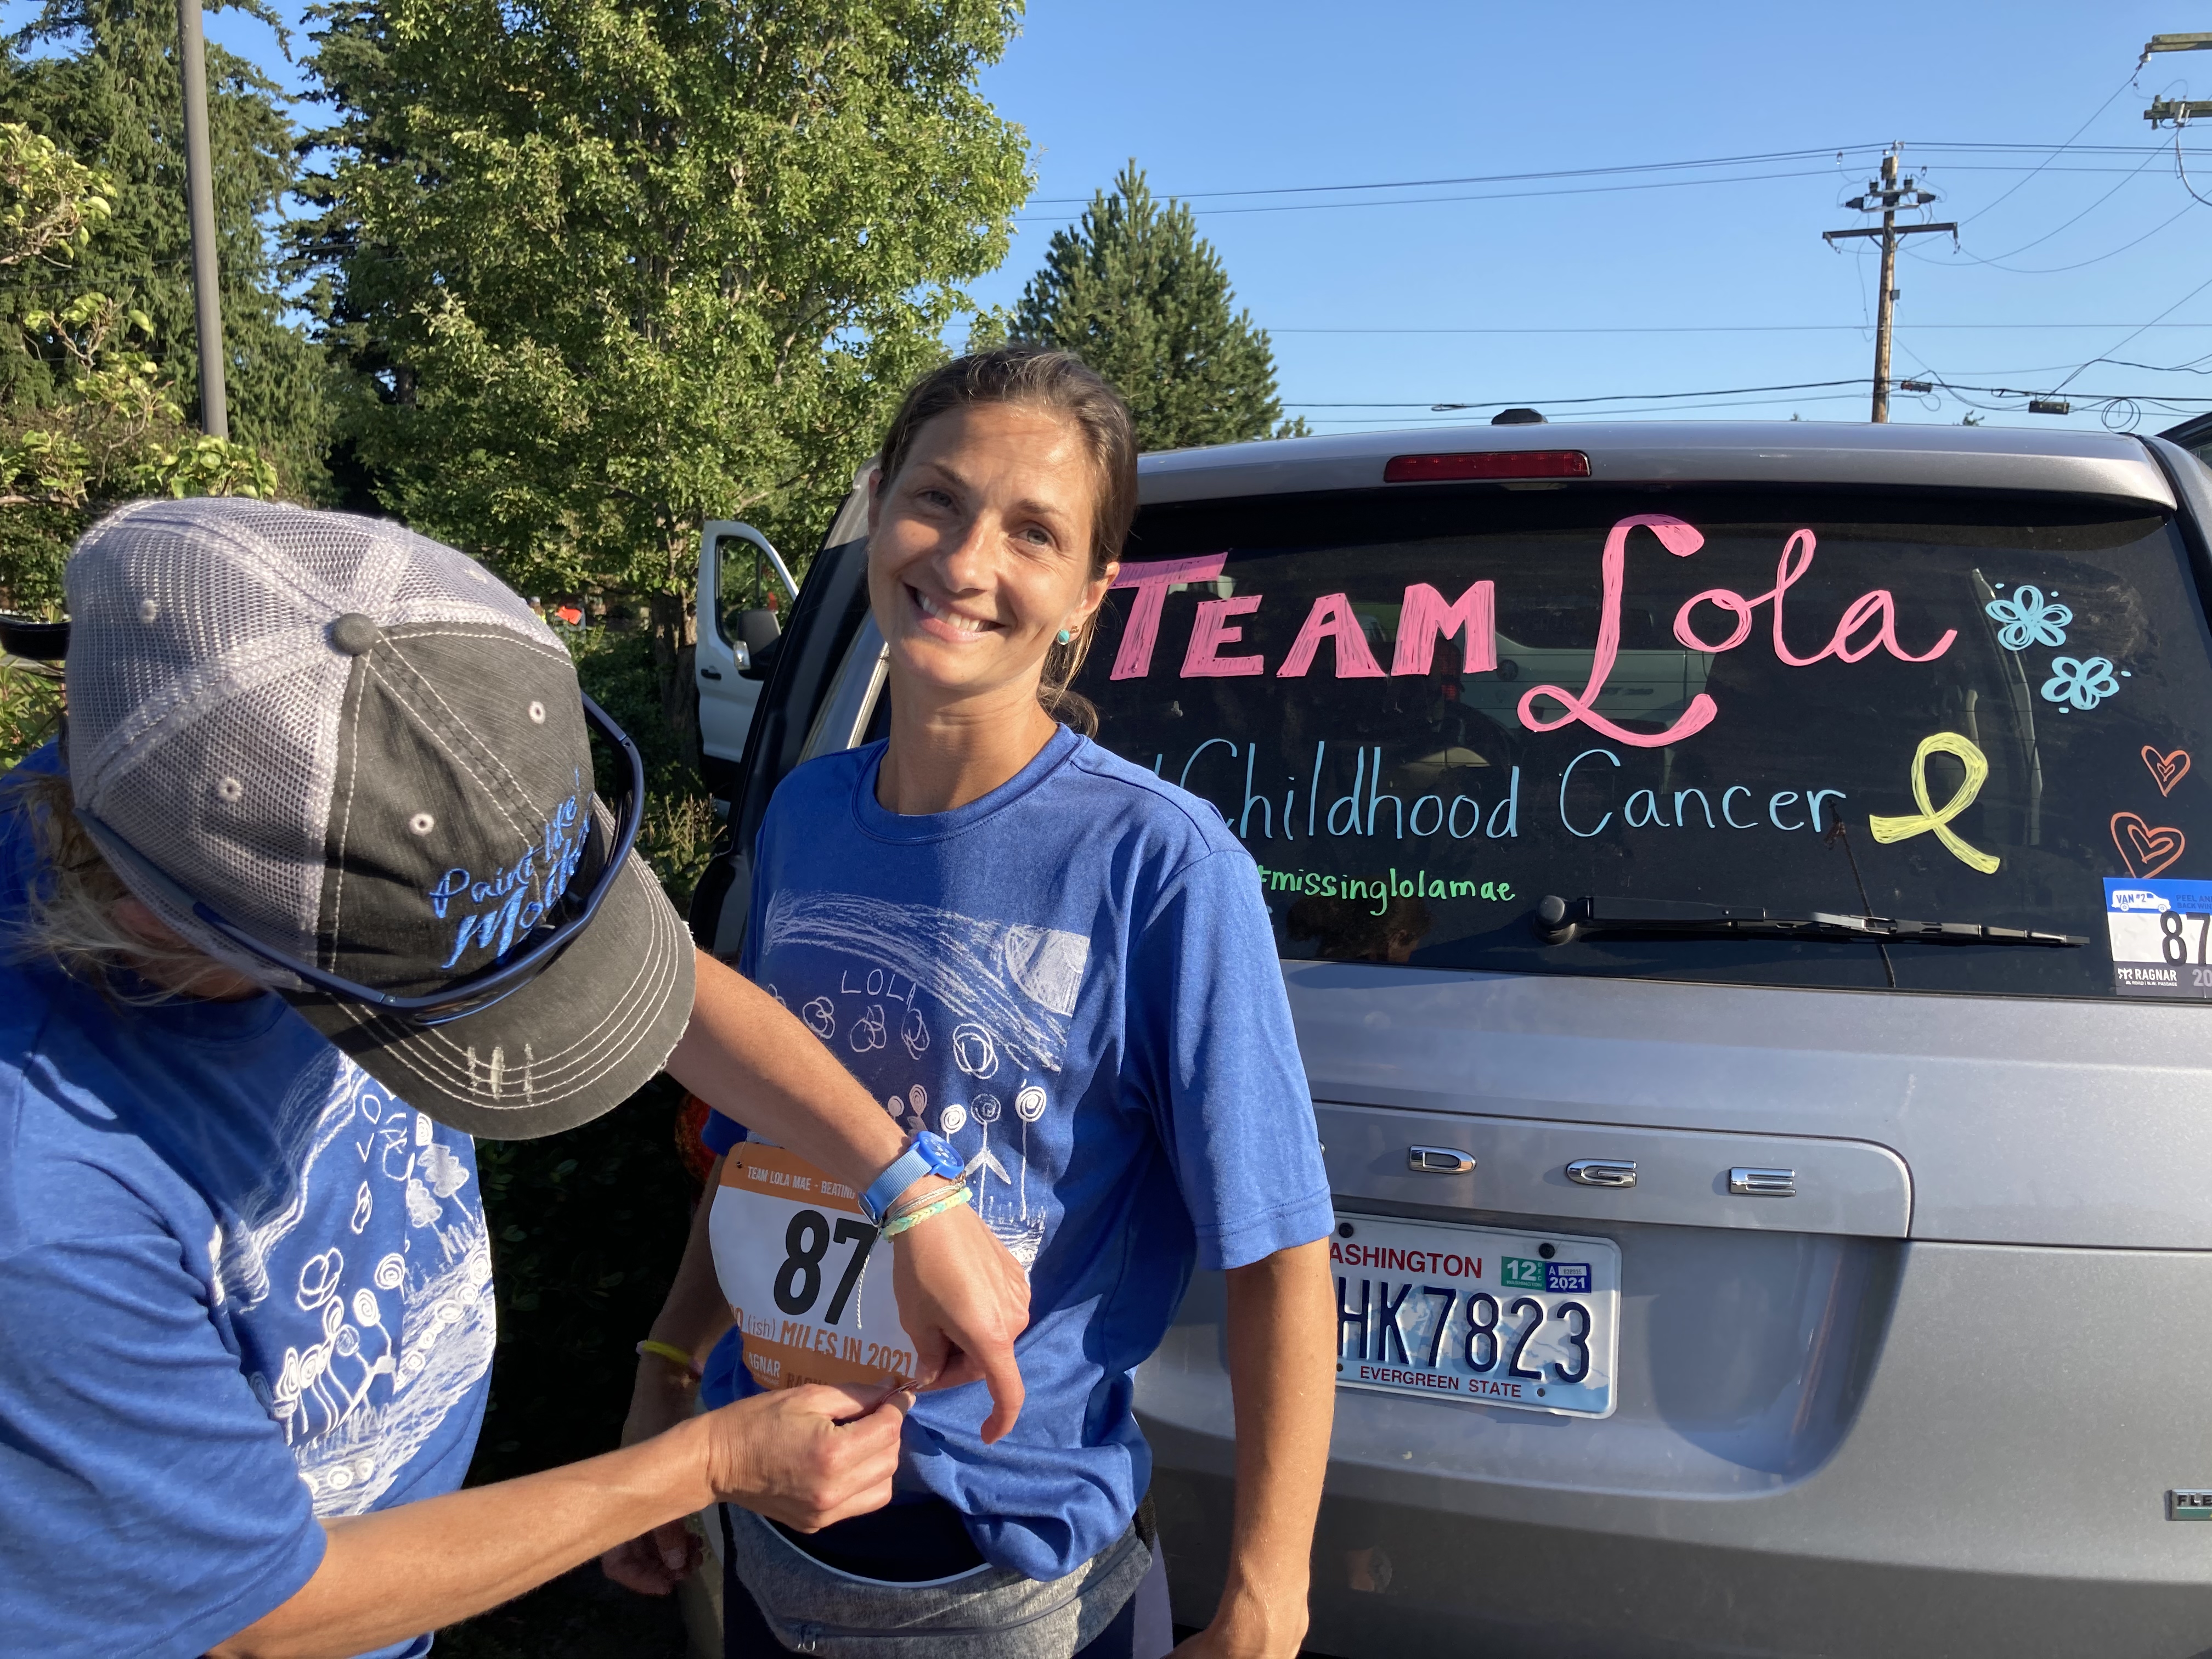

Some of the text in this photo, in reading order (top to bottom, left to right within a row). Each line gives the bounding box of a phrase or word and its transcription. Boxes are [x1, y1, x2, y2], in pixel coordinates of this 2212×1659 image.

[1109, 514, 1957, 748] TEAM Lola
[1180, 738, 1846, 840] Childhood Cancer
[2116, 894, 2146, 904] VAN #2
[2160, 911, 2211, 967] 87
[841, 969, 916, 1012] LOLA
[2135, 968, 2177, 981] RAGNAR
[748, 1166, 769, 1182] TEAM
[770, 1171, 790, 1187] LOLA
[792, 1176, 812, 1191] MAE
[1319, 1141, 1797, 1197] DGE
[774, 1209, 878, 1325] 87
[1330, 1243, 1482, 1279] ASHINGTON
[1507, 1260, 1537, 1282] 12
[1549, 1266, 1556, 1276] A
[1549, 1277, 1585, 1290] 2021
[748, 1314, 776, 1341] (ish)
[780, 1319, 838, 1358] MILES
[843, 1336, 863, 1365] IN
[866, 1342, 912, 1376] 2021
[1338, 1277, 1590, 1383] HK7823
[1361, 1365, 1521, 1398] EVERGREEN STATE
